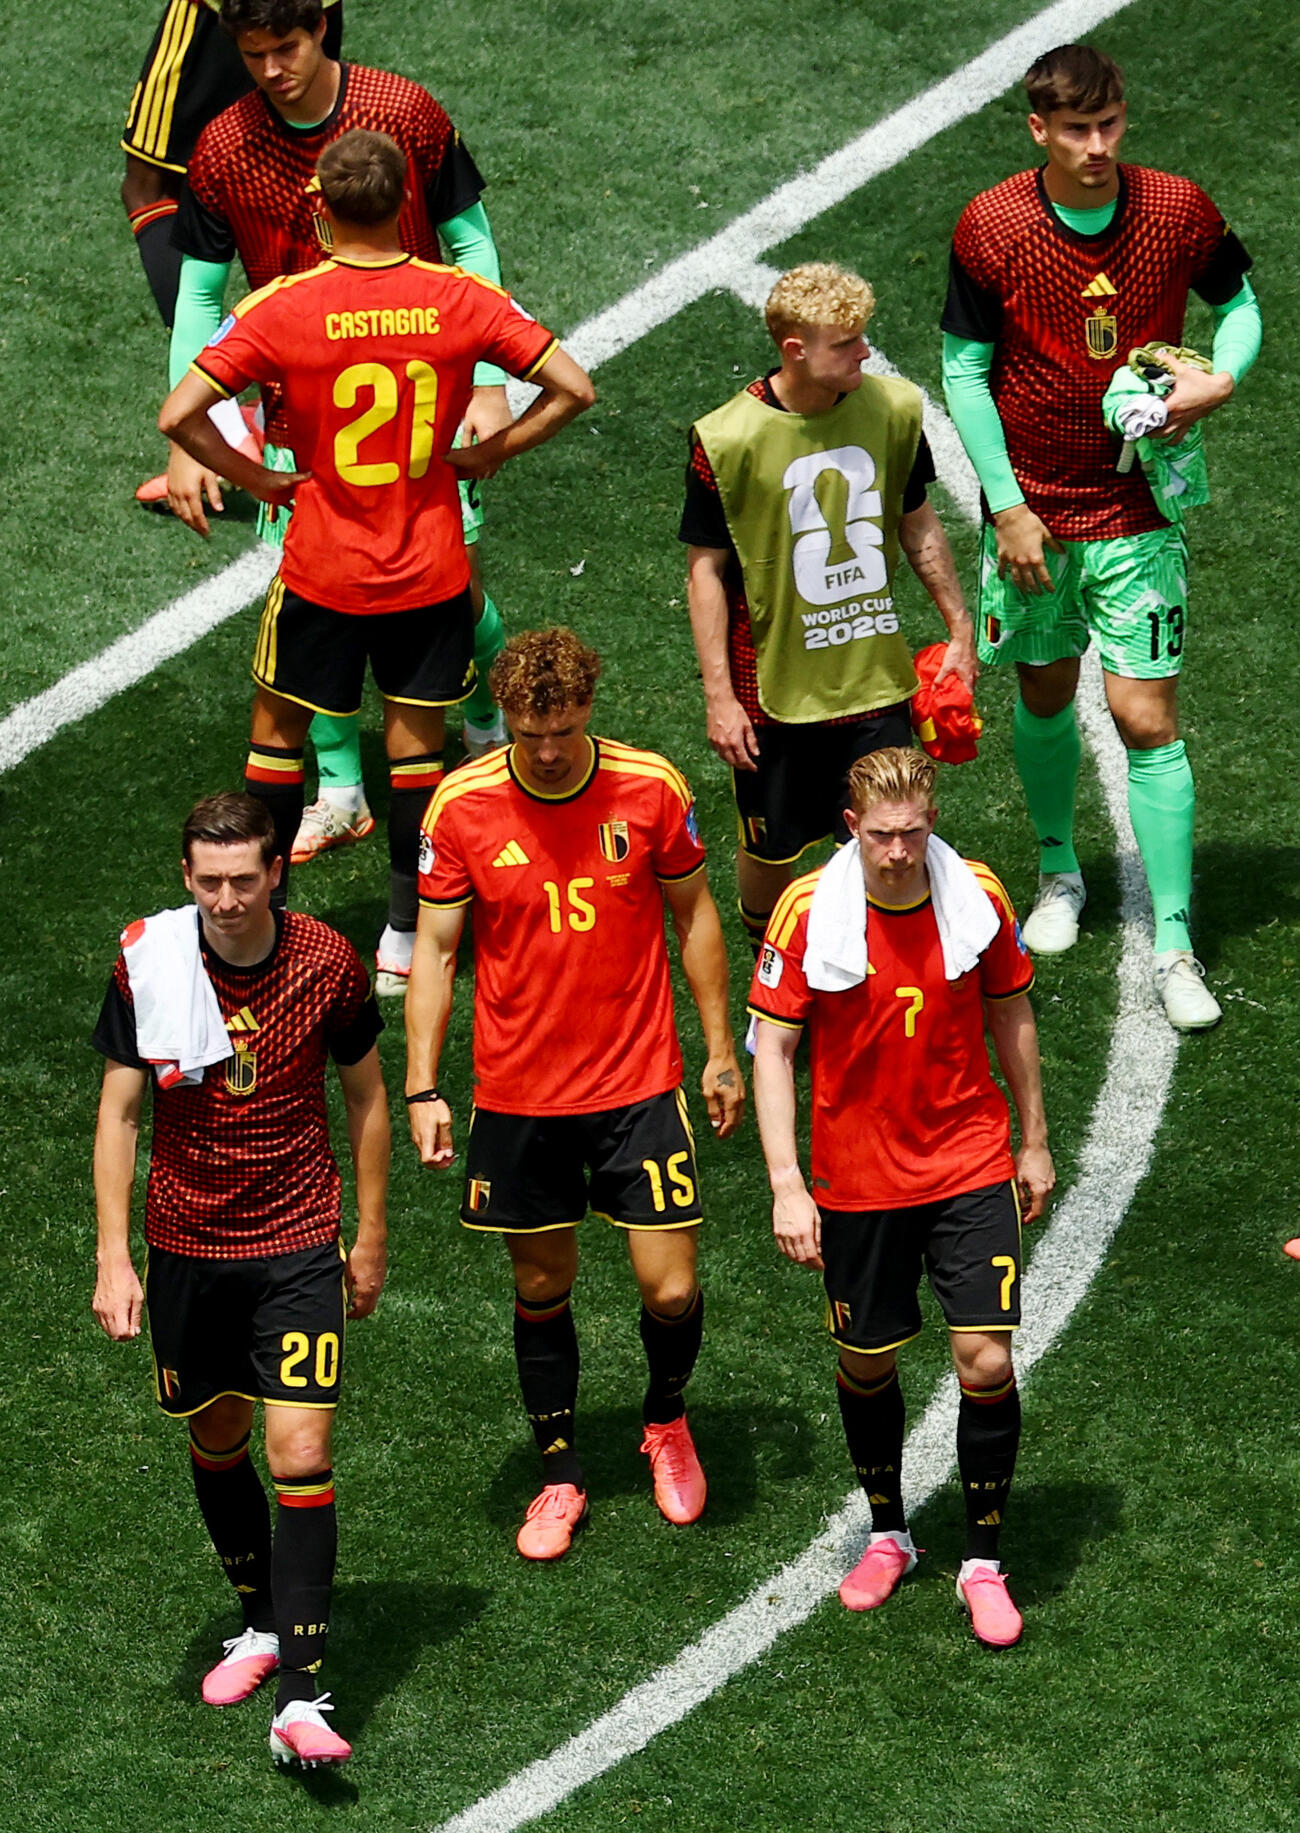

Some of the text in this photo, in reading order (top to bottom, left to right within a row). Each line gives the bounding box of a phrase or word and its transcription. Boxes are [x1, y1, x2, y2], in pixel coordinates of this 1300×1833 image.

[325, 307, 440, 340] CASTAGNE
[333, 359, 438, 487] 21
[825, 566, 865, 590] FIFA
[801, 602, 861, 627] WORLD
[803, 613, 899, 650] 2026
[1148, 605, 1184, 660] 13
[543, 877, 596, 933] 15
[895, 986, 924, 1038] 7
[642, 1150, 695, 1212] 15
[991, 1255, 1016, 1311] 7
[280, 1331, 339, 1388] 20
[294, 1623, 329, 1636] RBF
